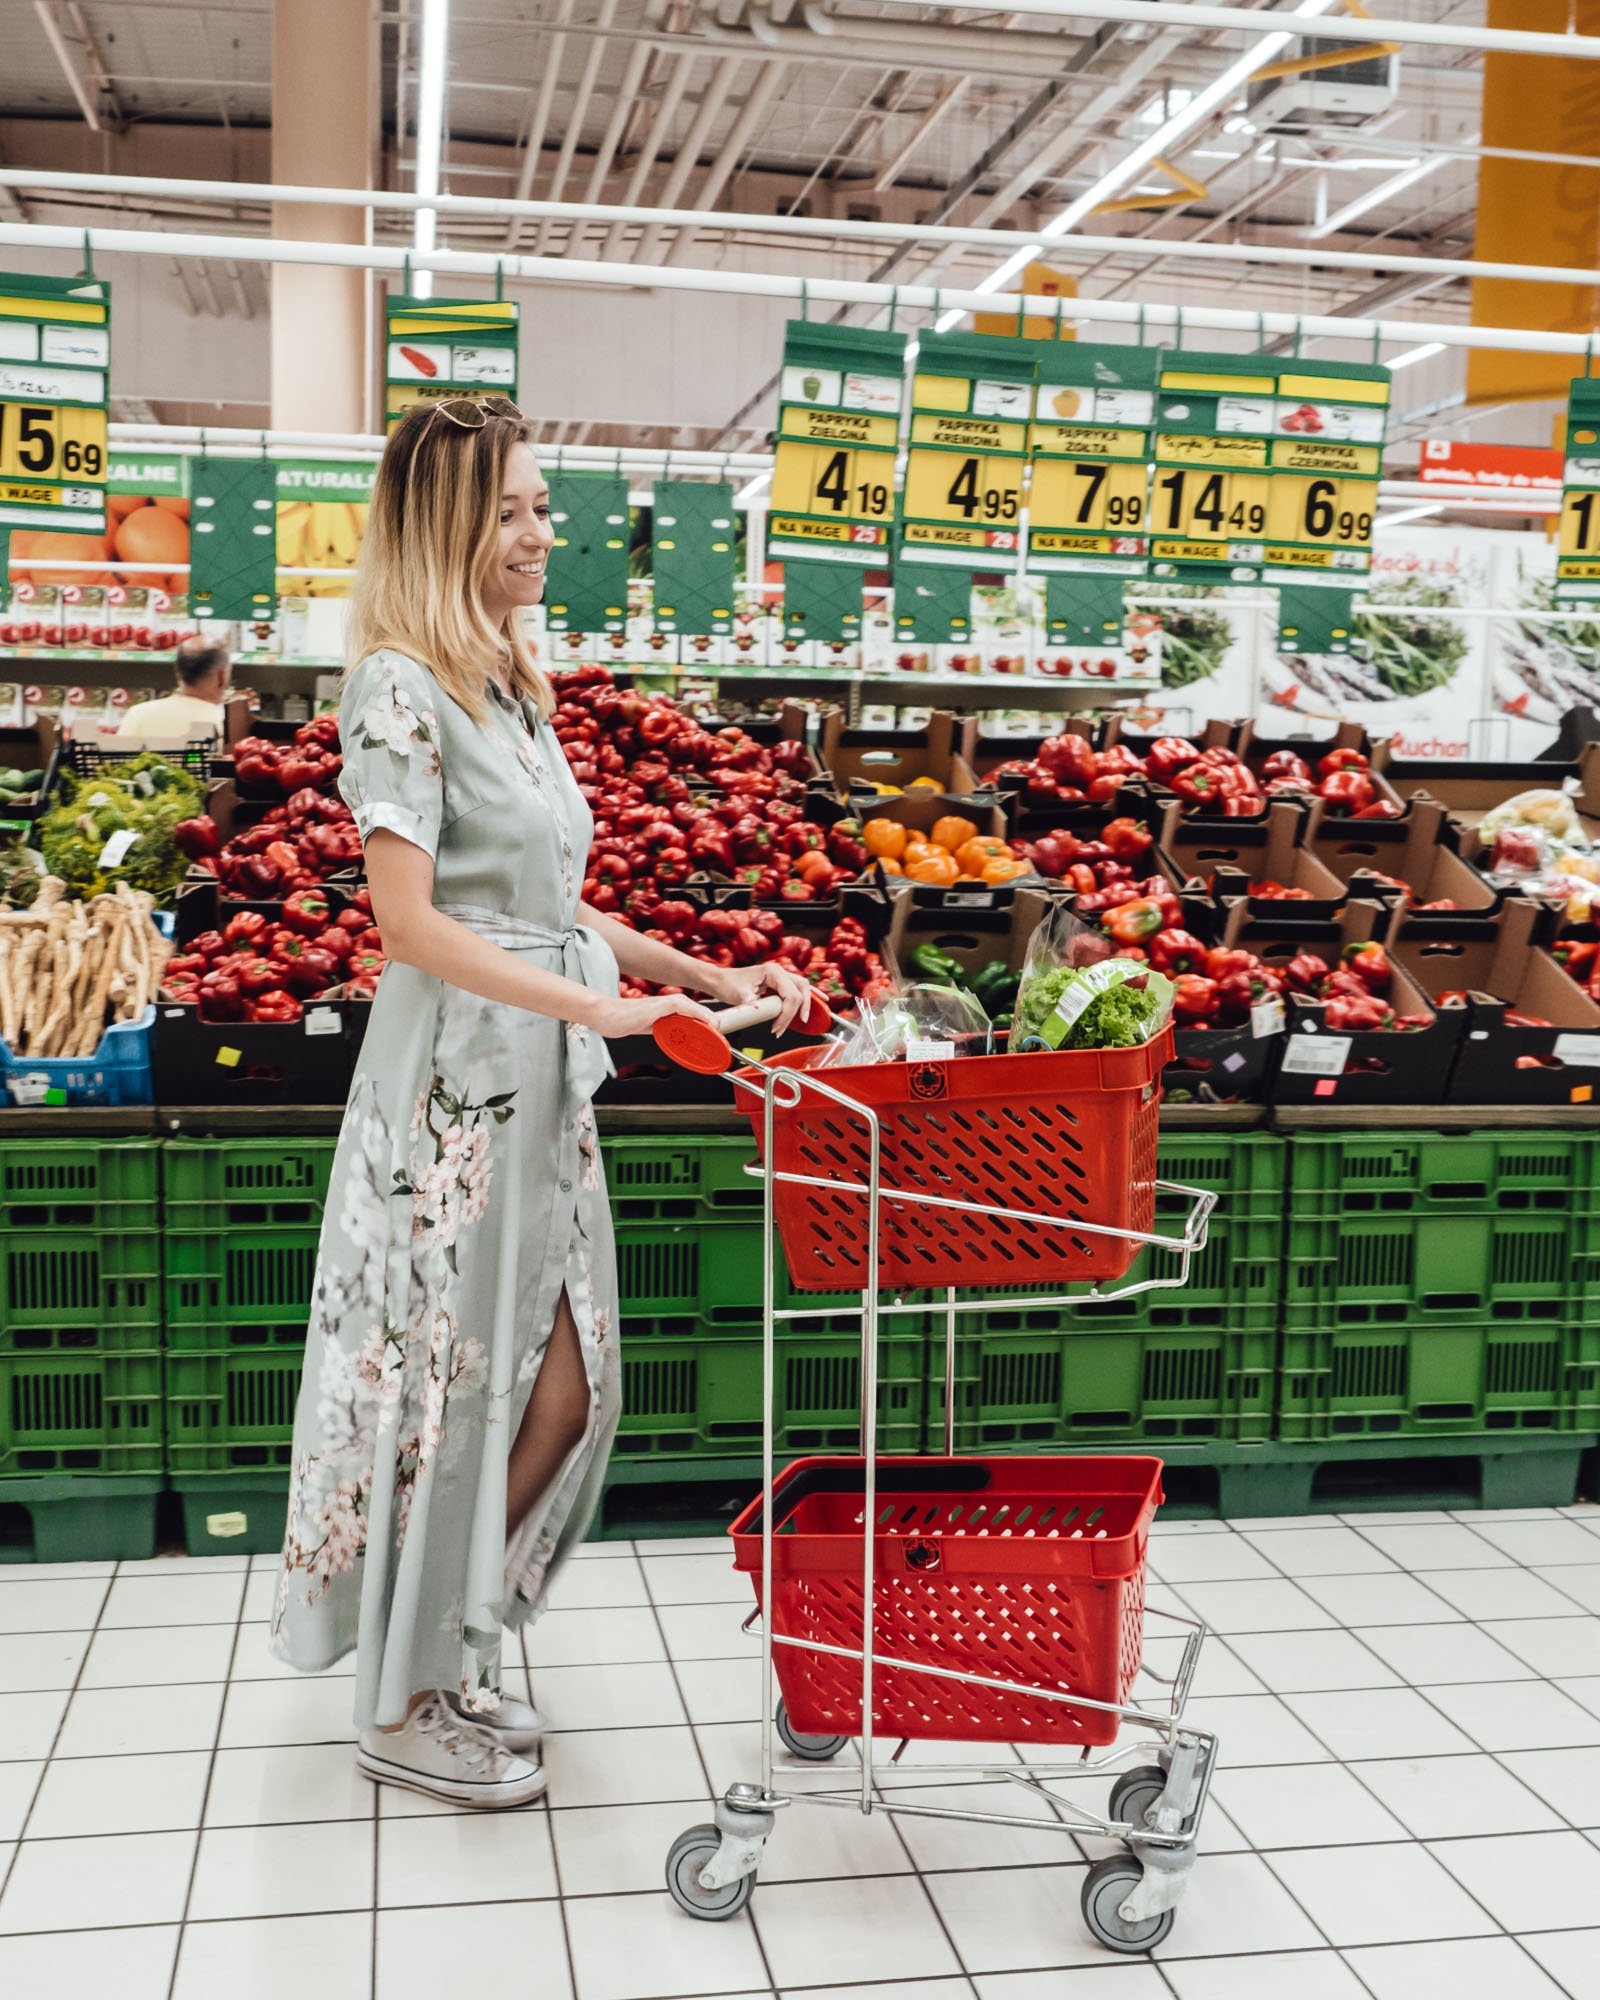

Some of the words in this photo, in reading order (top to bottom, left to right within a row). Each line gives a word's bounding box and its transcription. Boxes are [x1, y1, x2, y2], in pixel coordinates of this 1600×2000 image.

[808, 412, 871, 428] PAPRYKA
[937, 420, 999, 434] PAPRYKA
[0, 404, 55, 473] 5
[63, 440, 101, 476] 69
[808, 425, 869, 441] ZIELONA
[933, 433, 1002, 448] KREMOWA
[1057, 428, 1119, 441] PAPRYKA
[1296, 444, 1355, 457] PAPRYKA
[1287, 456, 1359, 470] CZERWONA
[816, 451, 849, 512] 4
[857, 482, 888, 515] 19
[947, 458, 980, 518] 4
[984, 489, 1018, 519] 95
[1074, 463, 1108, 523] 7
[1108, 496, 1142, 525] 99
[1161, 470, 1225, 533] 14
[1228, 501, 1265, 534] 49
[1304, 480, 1337, 538] 6
[1338, 512, 1372, 541] 99
[1570, 494, 1594, 550] 1
[777, 521, 796, 533] NA
[853, 525, 877, 543] 25
[911, 529, 929, 539] NA
[1037, 537, 1056, 547] NA
[1159, 545, 1177, 555] NA
[1267, 551, 1285, 561] NA
